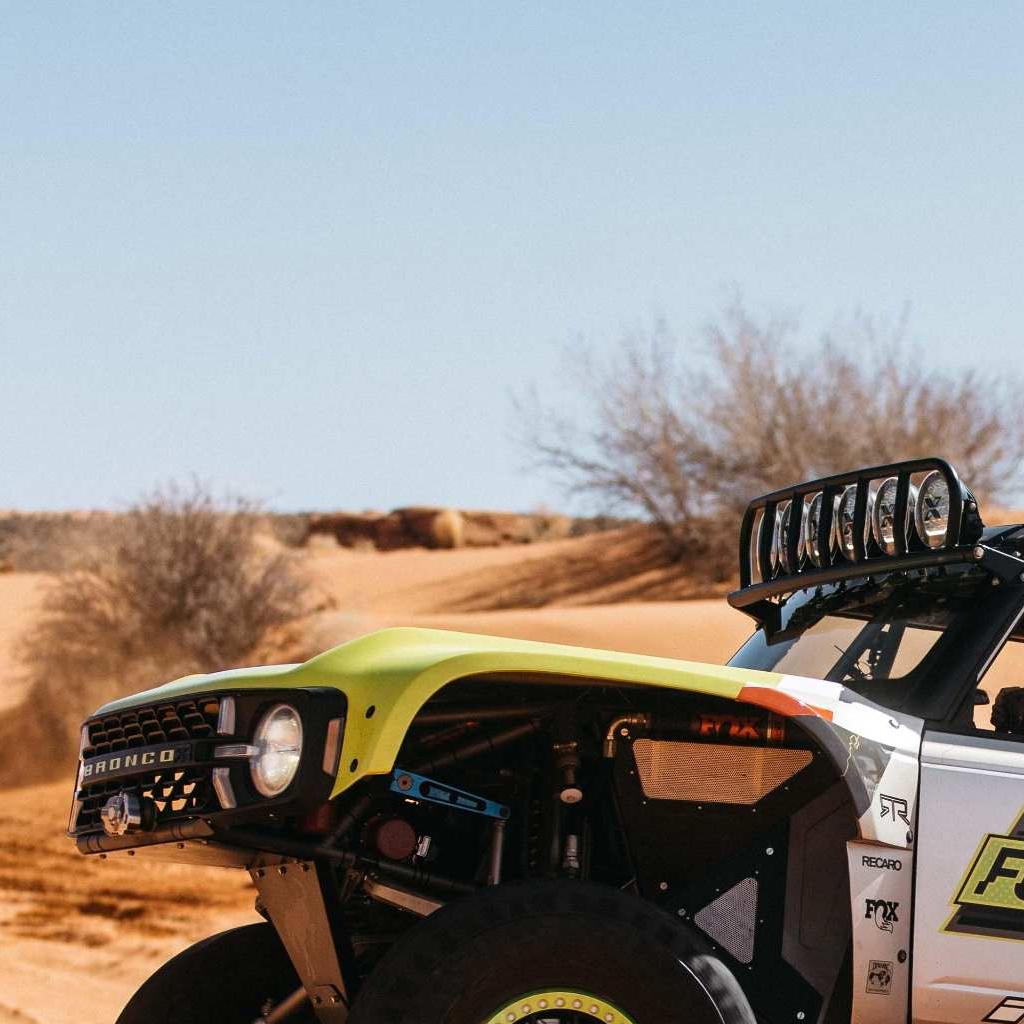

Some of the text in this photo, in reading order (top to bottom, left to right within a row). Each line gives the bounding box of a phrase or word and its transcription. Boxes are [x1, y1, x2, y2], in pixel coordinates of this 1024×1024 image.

[84, 749, 175, 777] BRONCO
[862, 855, 902, 871] RECARO
[864, 898, 899, 922] FOX
